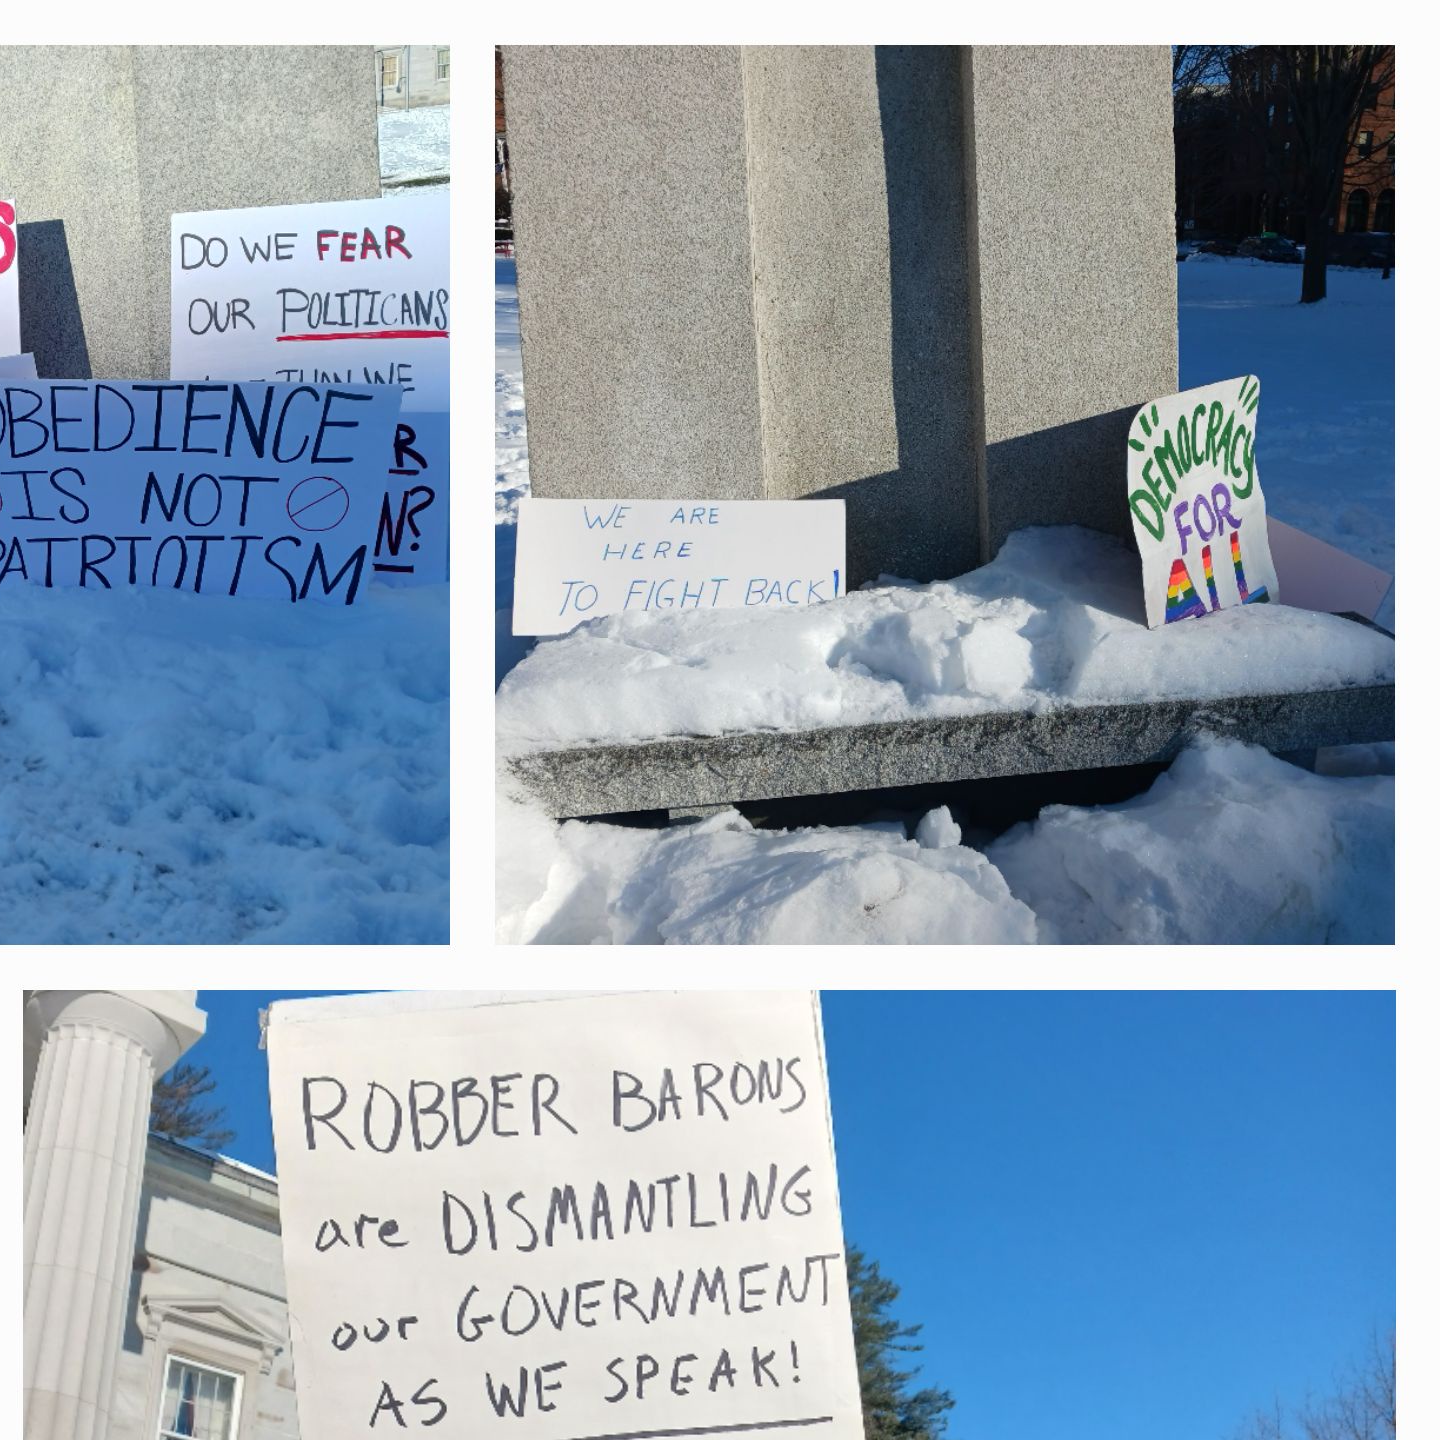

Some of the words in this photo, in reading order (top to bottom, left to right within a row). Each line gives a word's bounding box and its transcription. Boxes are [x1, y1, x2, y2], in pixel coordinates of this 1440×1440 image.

[180, 232, 229, 270] DO
[240, 232, 298, 264] WE
[316, 224, 413, 263] FEAR
[188, 297, 256, 335] OUR
[276, 287, 449, 333] POLITICANS
[0, 466, 90, 524] IS
[140, 470, 280, 527] NOT
[1128, 400, 1255, 543] DEMOCRACY
[583, 503, 632, 530] WE
[670, 506, 720, 526] ARE
[603, 540, 694, 561] HERE
[1173, 482, 1243, 556] FOR
[558, 580, 599, 617] TO
[623, 578, 730, 612] FIGHT
[745, 569, 840, 607] BACK!
[1164, 530, 1271, 625] ALL
[301, 1072, 578, 1153] ROBBER
[612, 1056, 808, 1132] BARONS
[314, 1212, 409, 1252] are
[441, 1163, 814, 1255] DISMANTLING
[331, 1315, 419, 1351] our
[456, 1253, 841, 1342] GOVERNMENT
[368, 1378, 449, 1428] AS
[485, 1360, 569, 1418] WE
[604, 1340, 802, 1404] SPEAK!
